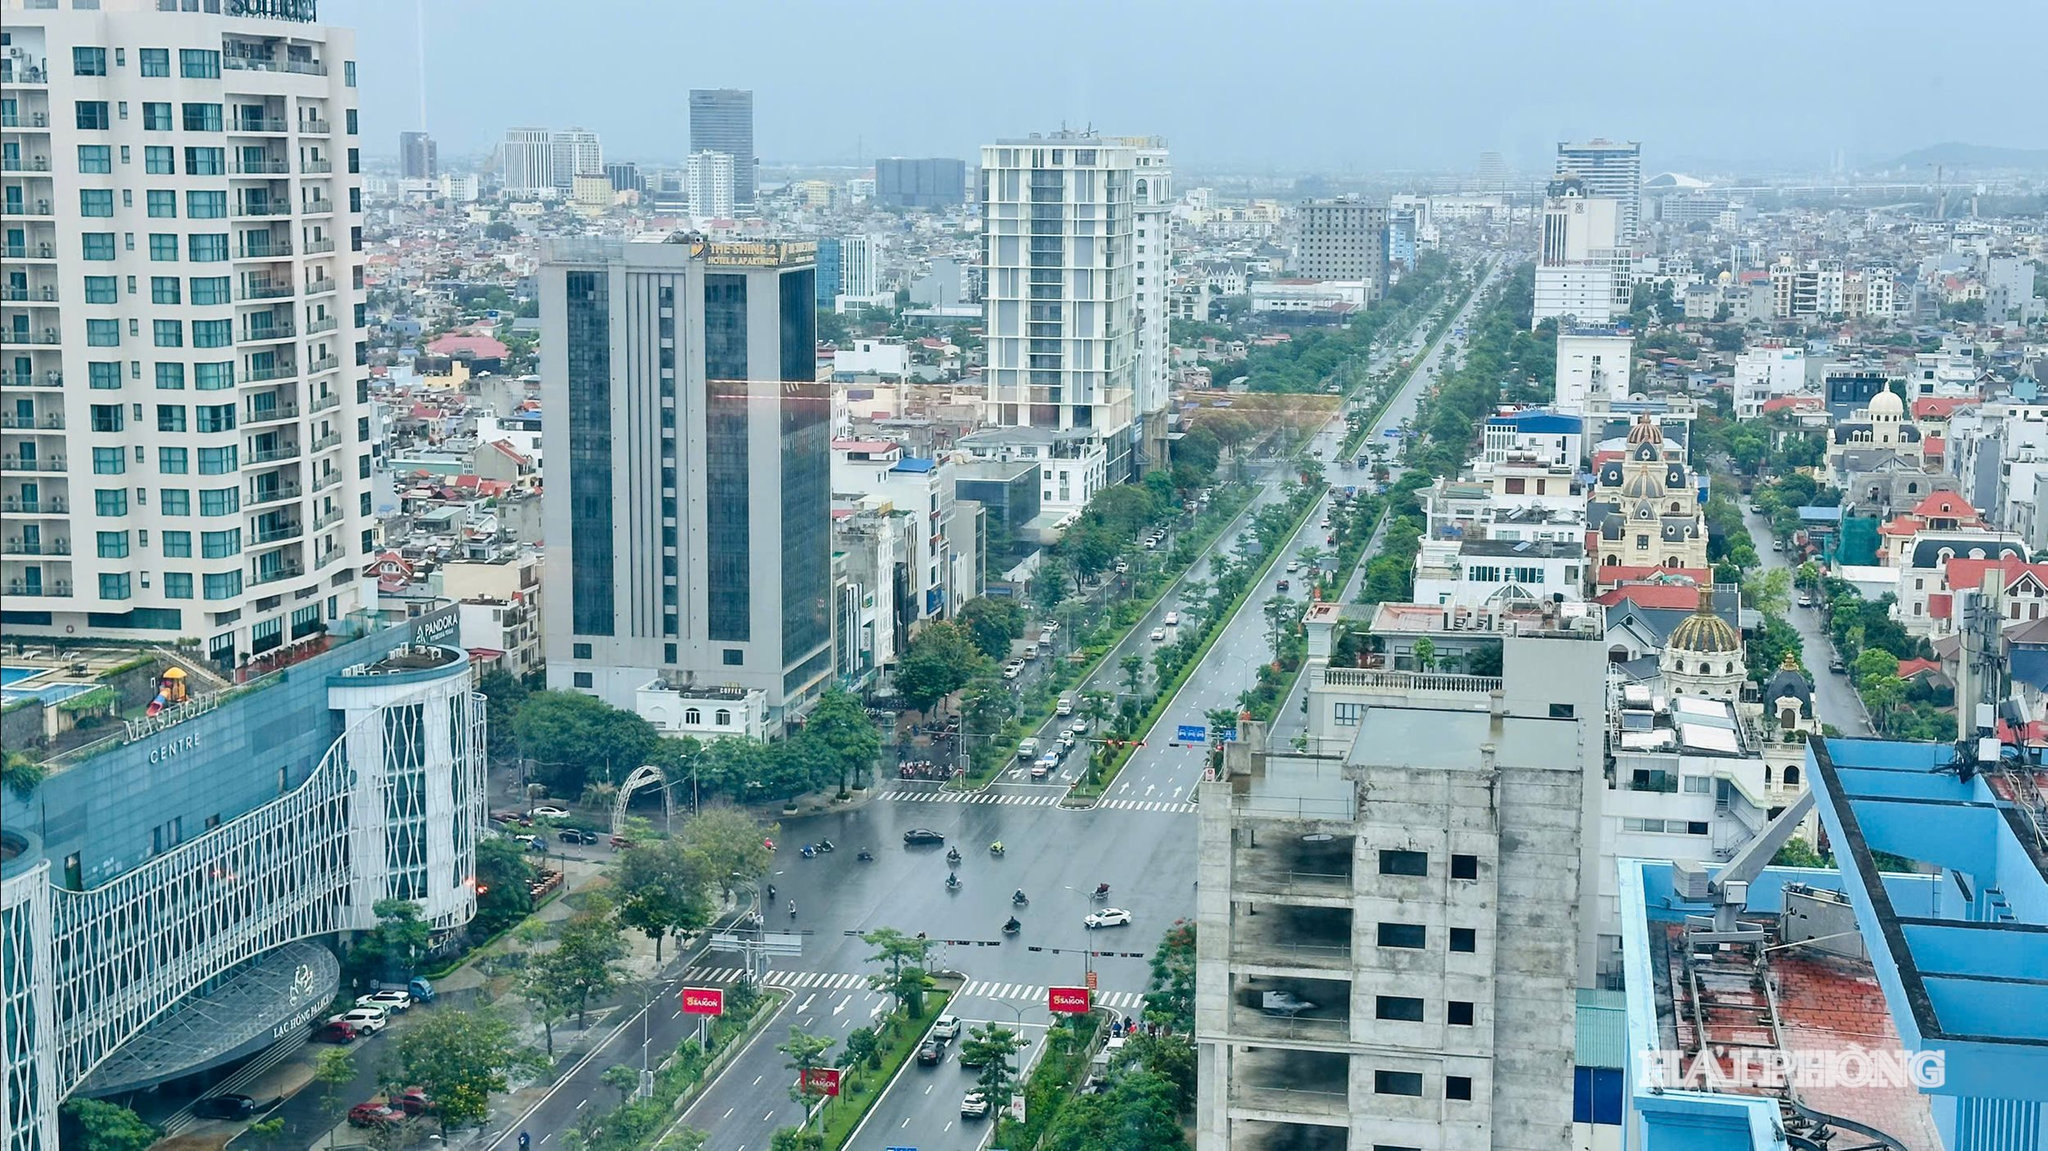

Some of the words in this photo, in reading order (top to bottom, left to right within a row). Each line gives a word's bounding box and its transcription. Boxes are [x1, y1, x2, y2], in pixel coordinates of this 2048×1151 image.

[710, 243, 731, 254] THE
[733, 243, 766, 255] SHINE
[768, 244, 777, 255] 2
[424, 612, 458, 637] PANDORA
[720, 687, 742, 695] COFFEE
[150, 732, 200, 764] CENTRE
